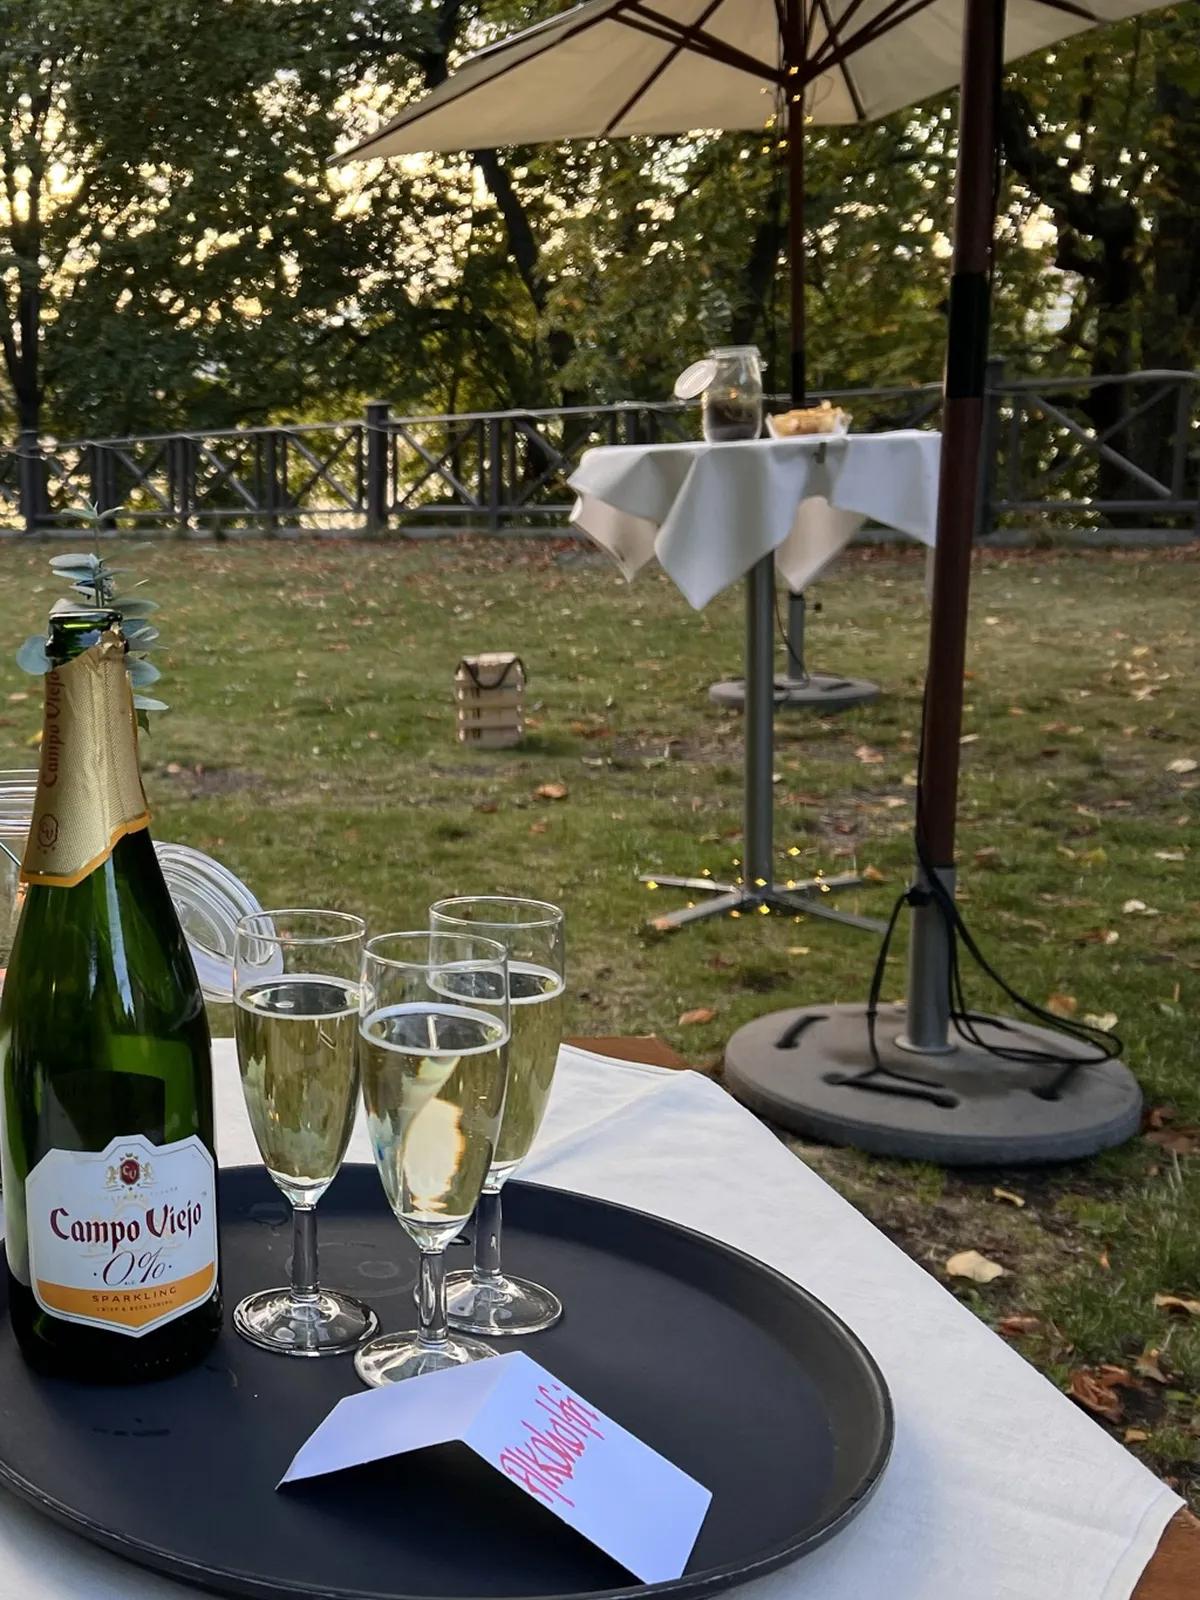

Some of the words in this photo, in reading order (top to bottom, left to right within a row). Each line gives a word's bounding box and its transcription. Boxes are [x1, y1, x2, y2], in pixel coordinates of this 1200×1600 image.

[45, 671, 66, 720] Viejo
[42, 724, 66, 789] Campo
[50, 1207, 140, 1254] Campo
[145, 1200, 202, 1239] Viejo
[102, 1246, 166, 1287] 0%
[91, 1286, 177, 1303] SPARKLING
